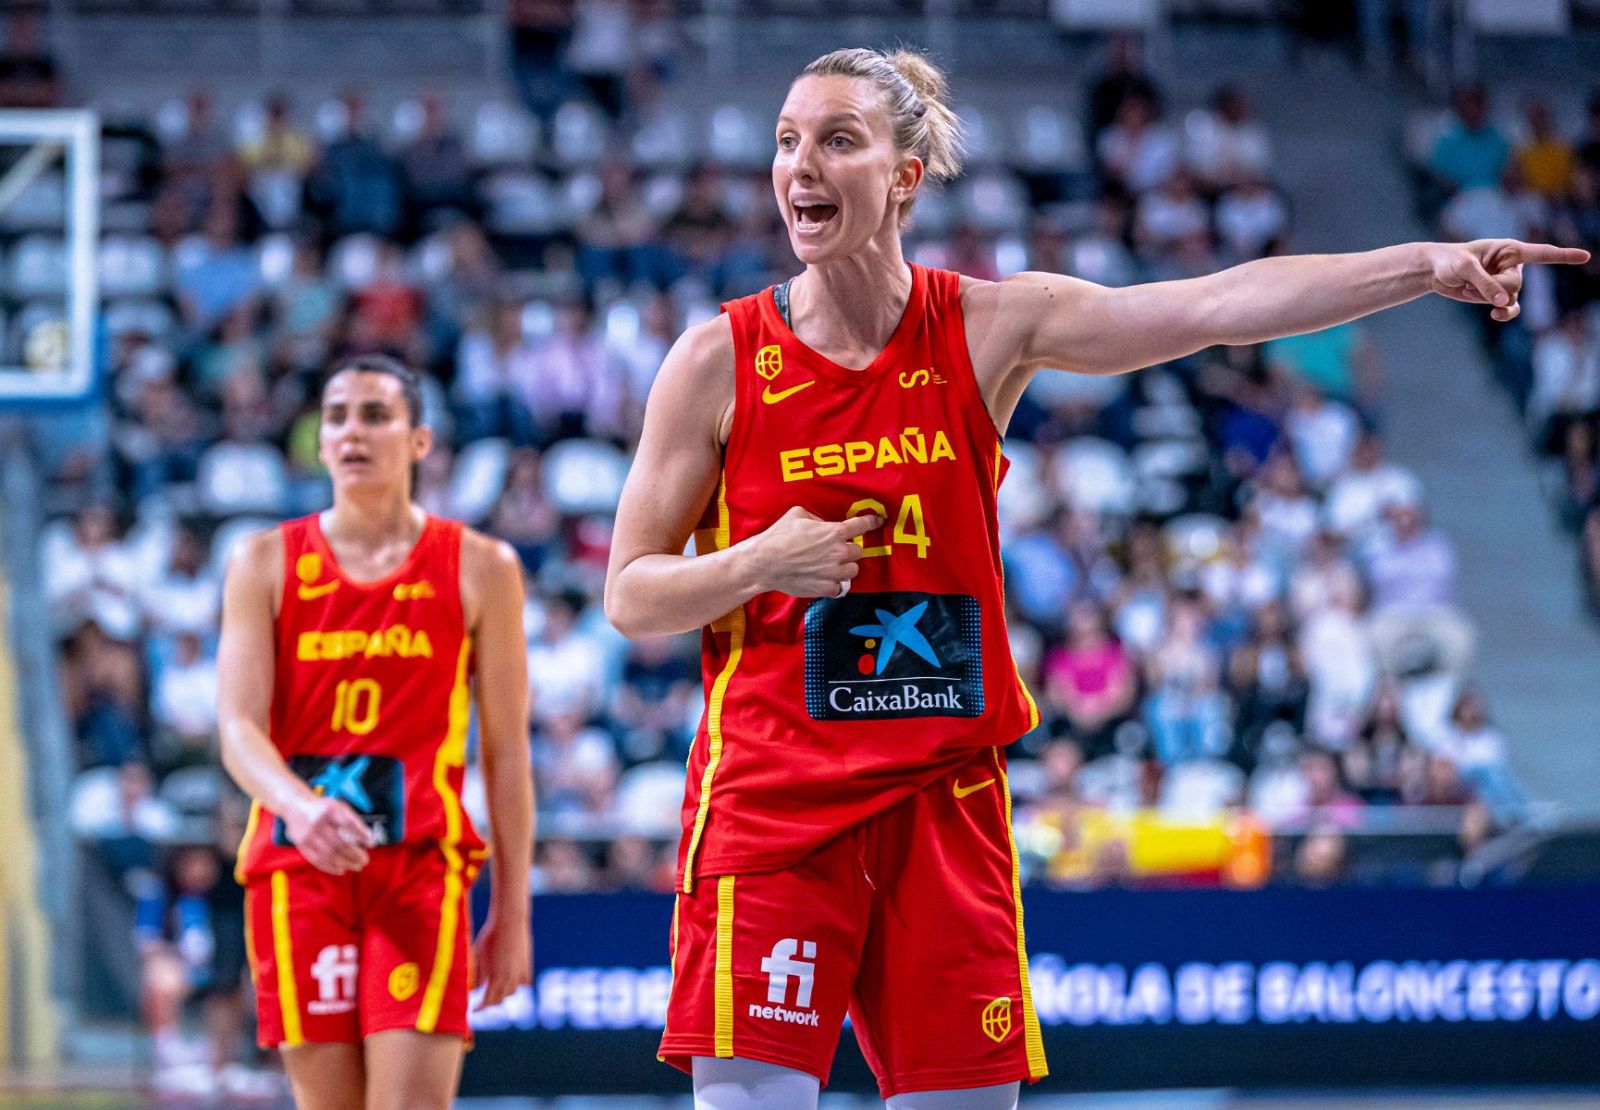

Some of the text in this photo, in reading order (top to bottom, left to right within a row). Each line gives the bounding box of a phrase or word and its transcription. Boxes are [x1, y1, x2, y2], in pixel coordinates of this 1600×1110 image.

[779, 427, 956, 482] ESPAÑA
[846, 493, 931, 559] 24
[297, 624, 433, 661] ESPAÑA
[331, 678, 381, 735] 10
[829, 683, 964, 713] CaixaBank
[760, 938, 817, 1008] fi
[1175, 961, 1255, 1025] DE
[1257, 959, 1600, 1024] BALONCESTO
[748, 1003, 819, 1027] network
